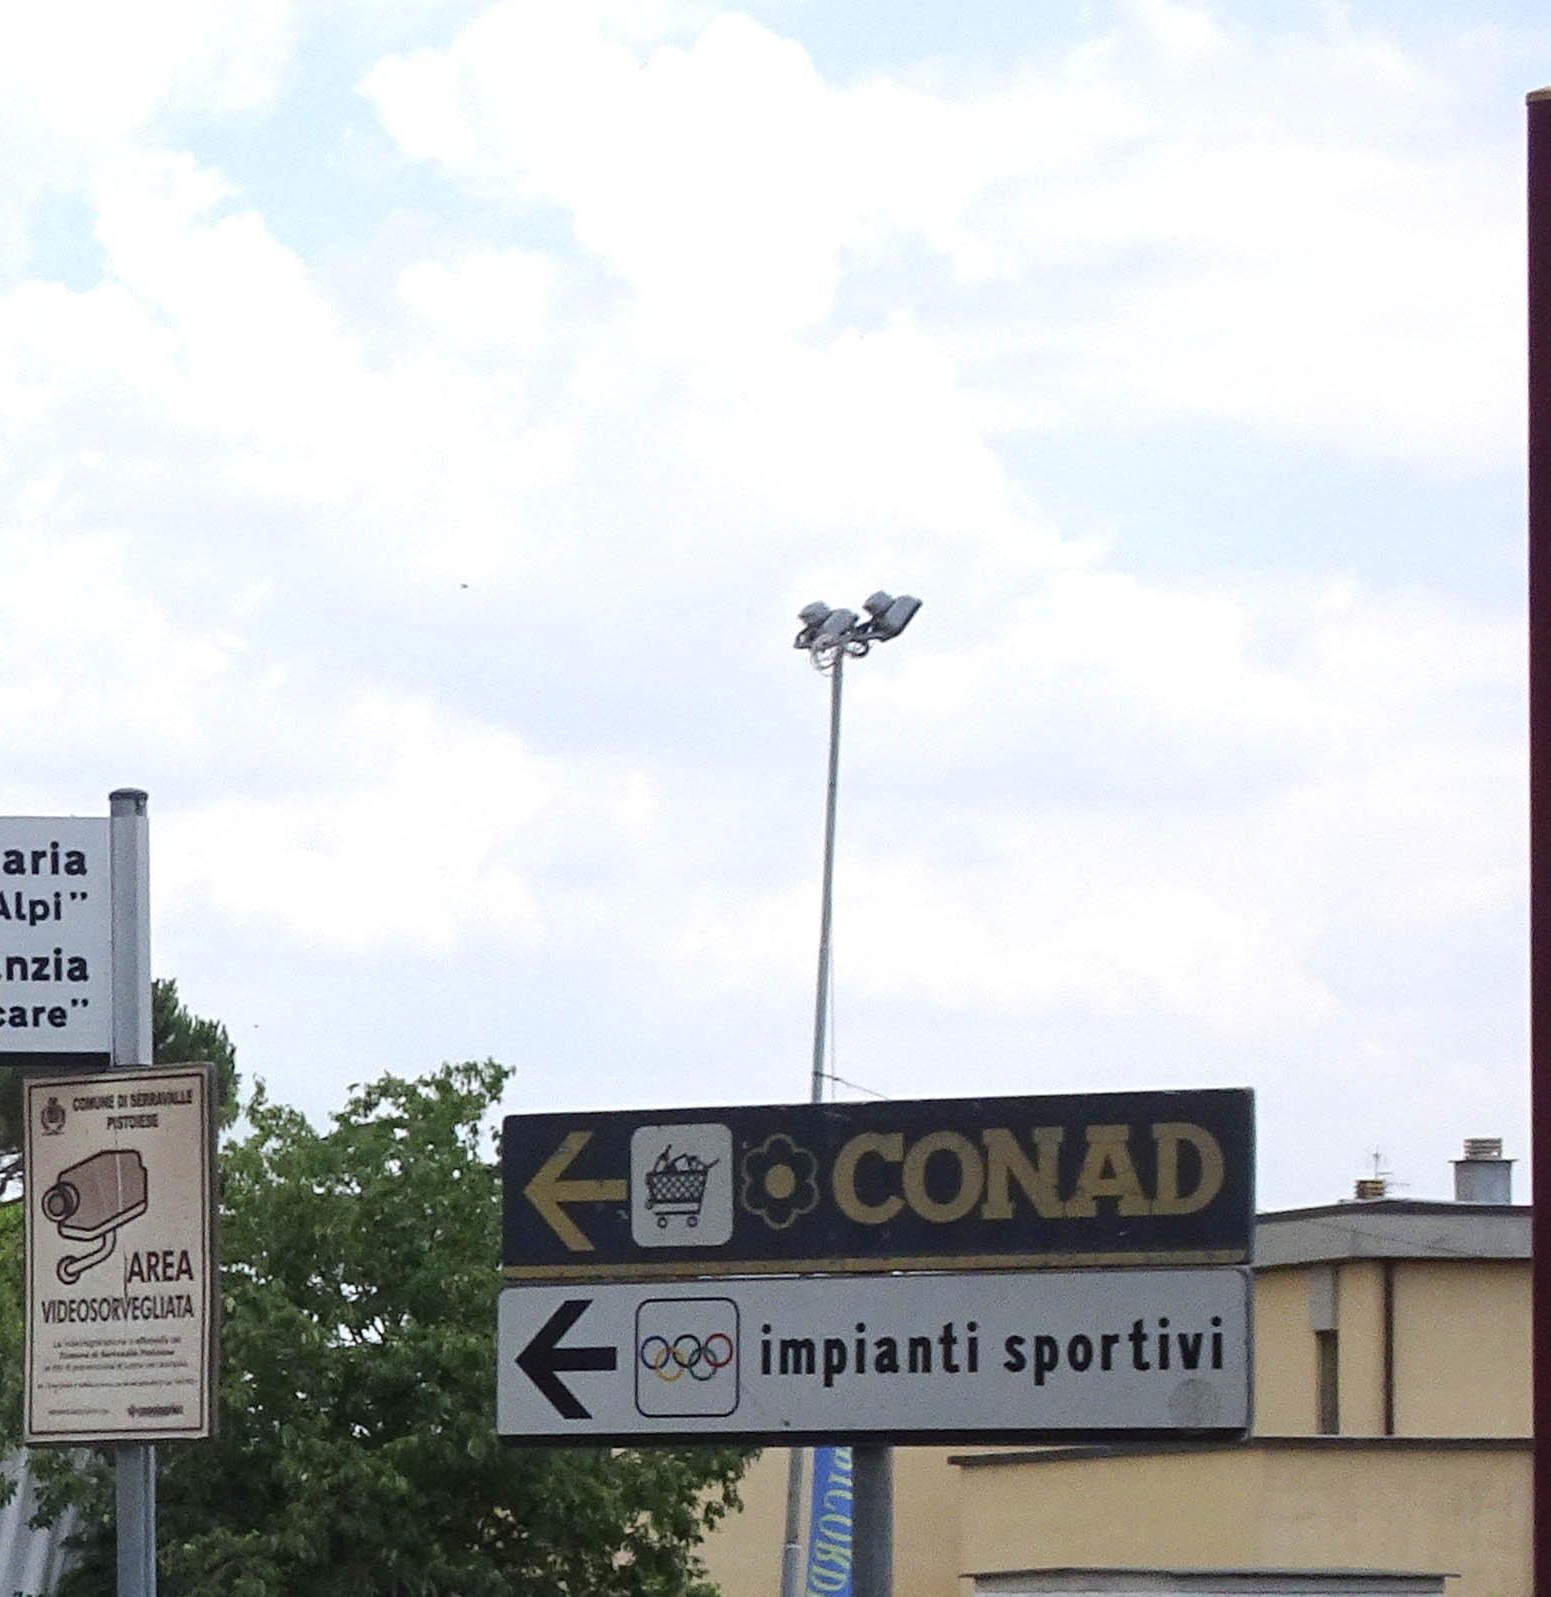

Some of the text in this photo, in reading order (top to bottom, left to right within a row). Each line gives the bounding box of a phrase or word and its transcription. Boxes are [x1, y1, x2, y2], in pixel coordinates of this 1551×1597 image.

[831, 1122, 1226, 1226] CONAD
[127, 1249, 195, 1284] AREA
[41, 1294, 195, 1325] VIDEOSORVEGLIATA
[760, 1315, 1225, 1387] impianti sportivi
